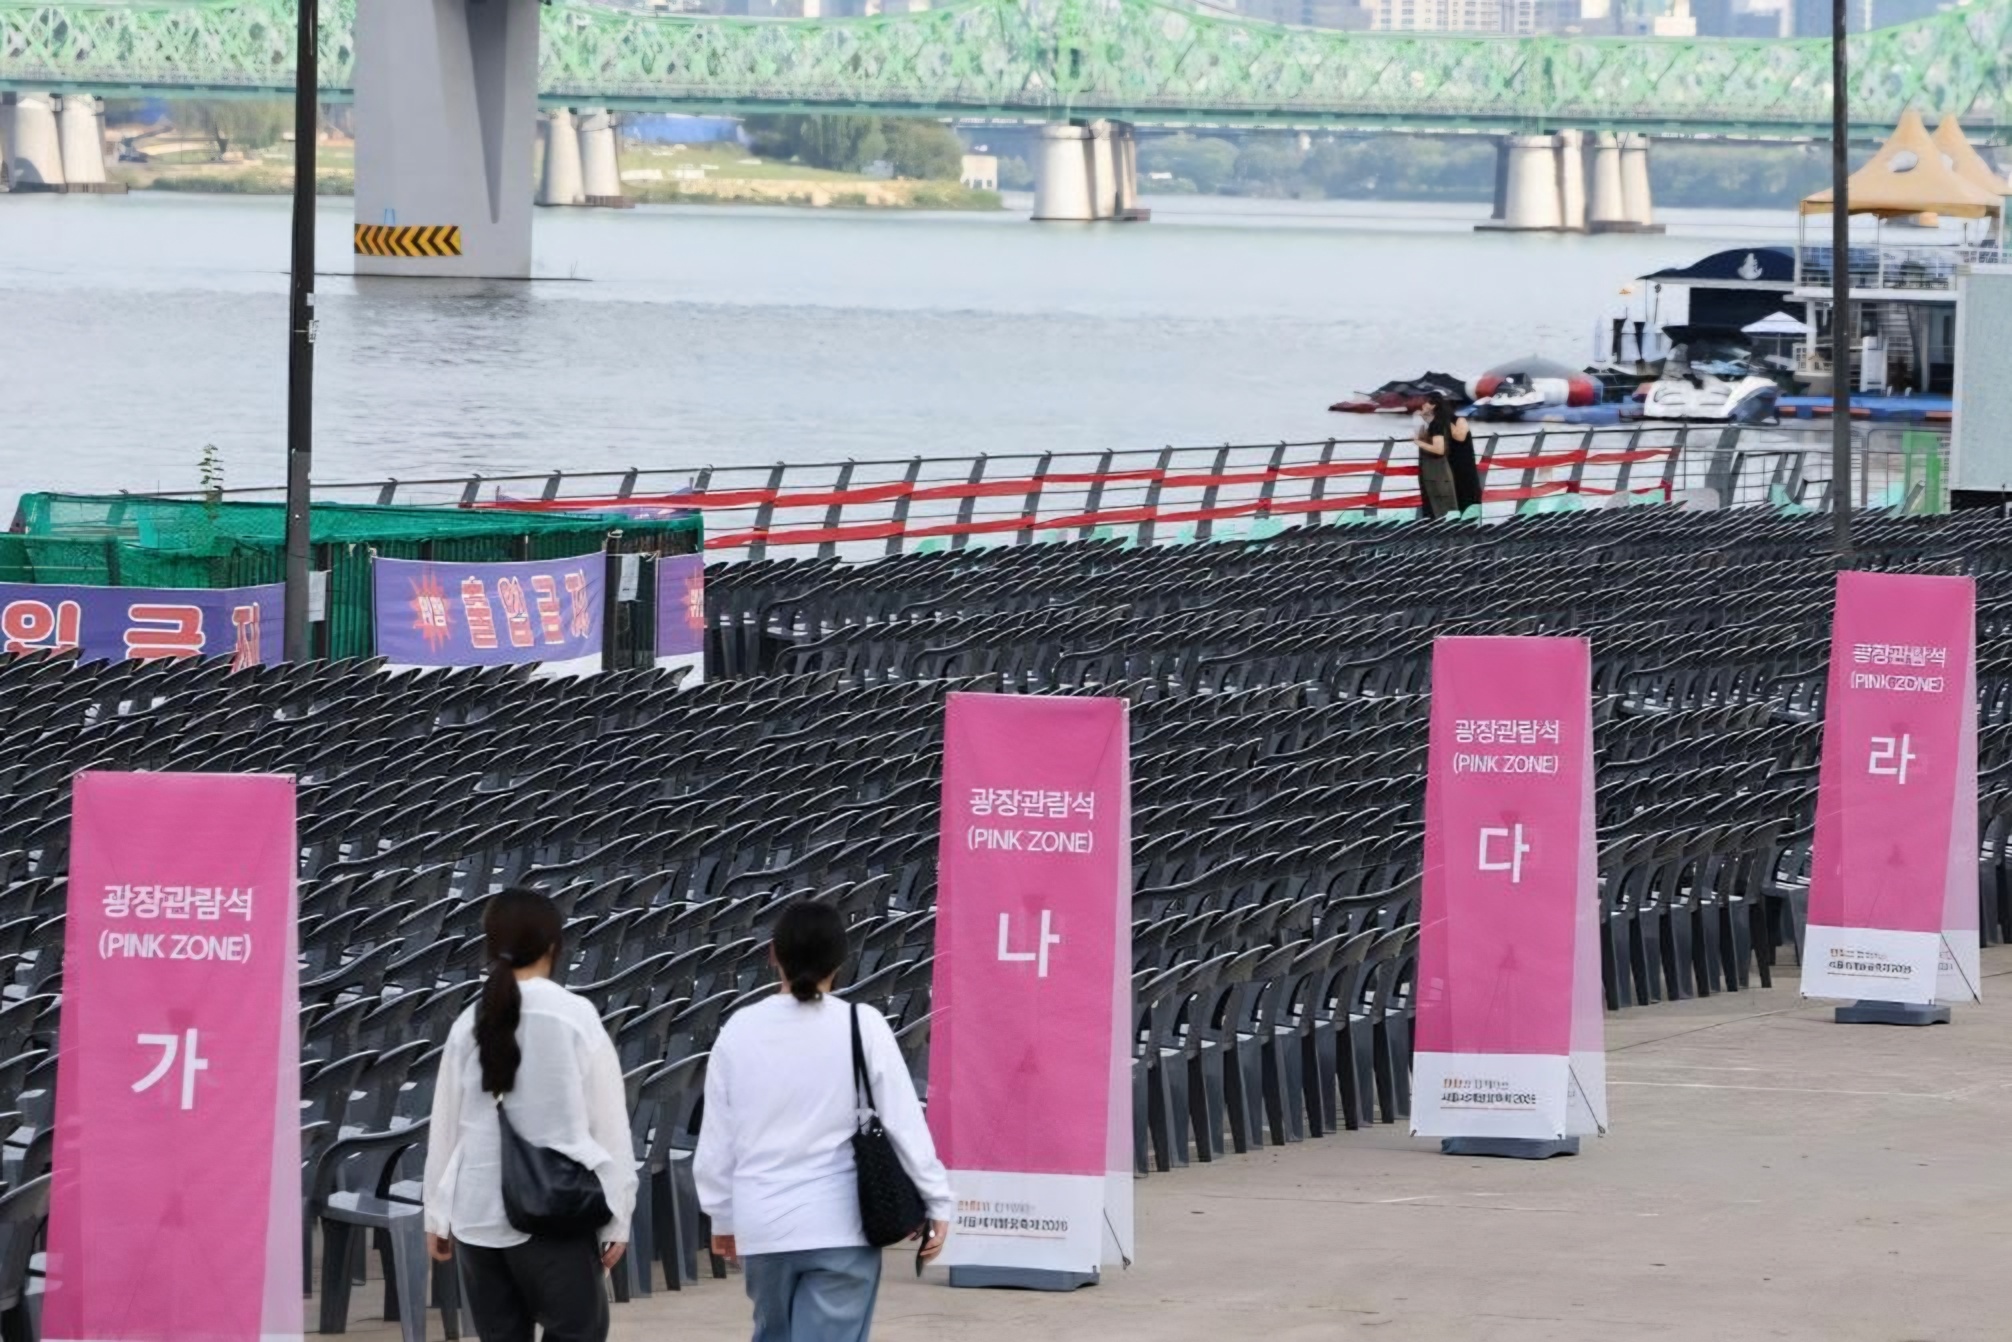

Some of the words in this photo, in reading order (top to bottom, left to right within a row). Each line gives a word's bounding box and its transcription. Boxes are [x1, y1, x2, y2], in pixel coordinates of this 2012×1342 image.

[1455, 719, 1559, 744] 광장관람석
[1453, 752, 1499, 774] (PINK
[1502, 755, 1559, 774] ZONE)
[1868, 733, 1916, 785] 라
[969, 788, 1095, 820] 광장관람석
[967, 825, 1024, 851] (PINK
[1027, 829, 1093, 854] ZONE)
[1478, 823, 1530, 883] 다
[102, 884, 253, 921] 광장관람석
[98, 929, 166, 960] (PINK
[169, 933, 252, 965] ZONE)
[997, 909, 1061, 978] 나
[131, 1028, 209, 1110] 가
